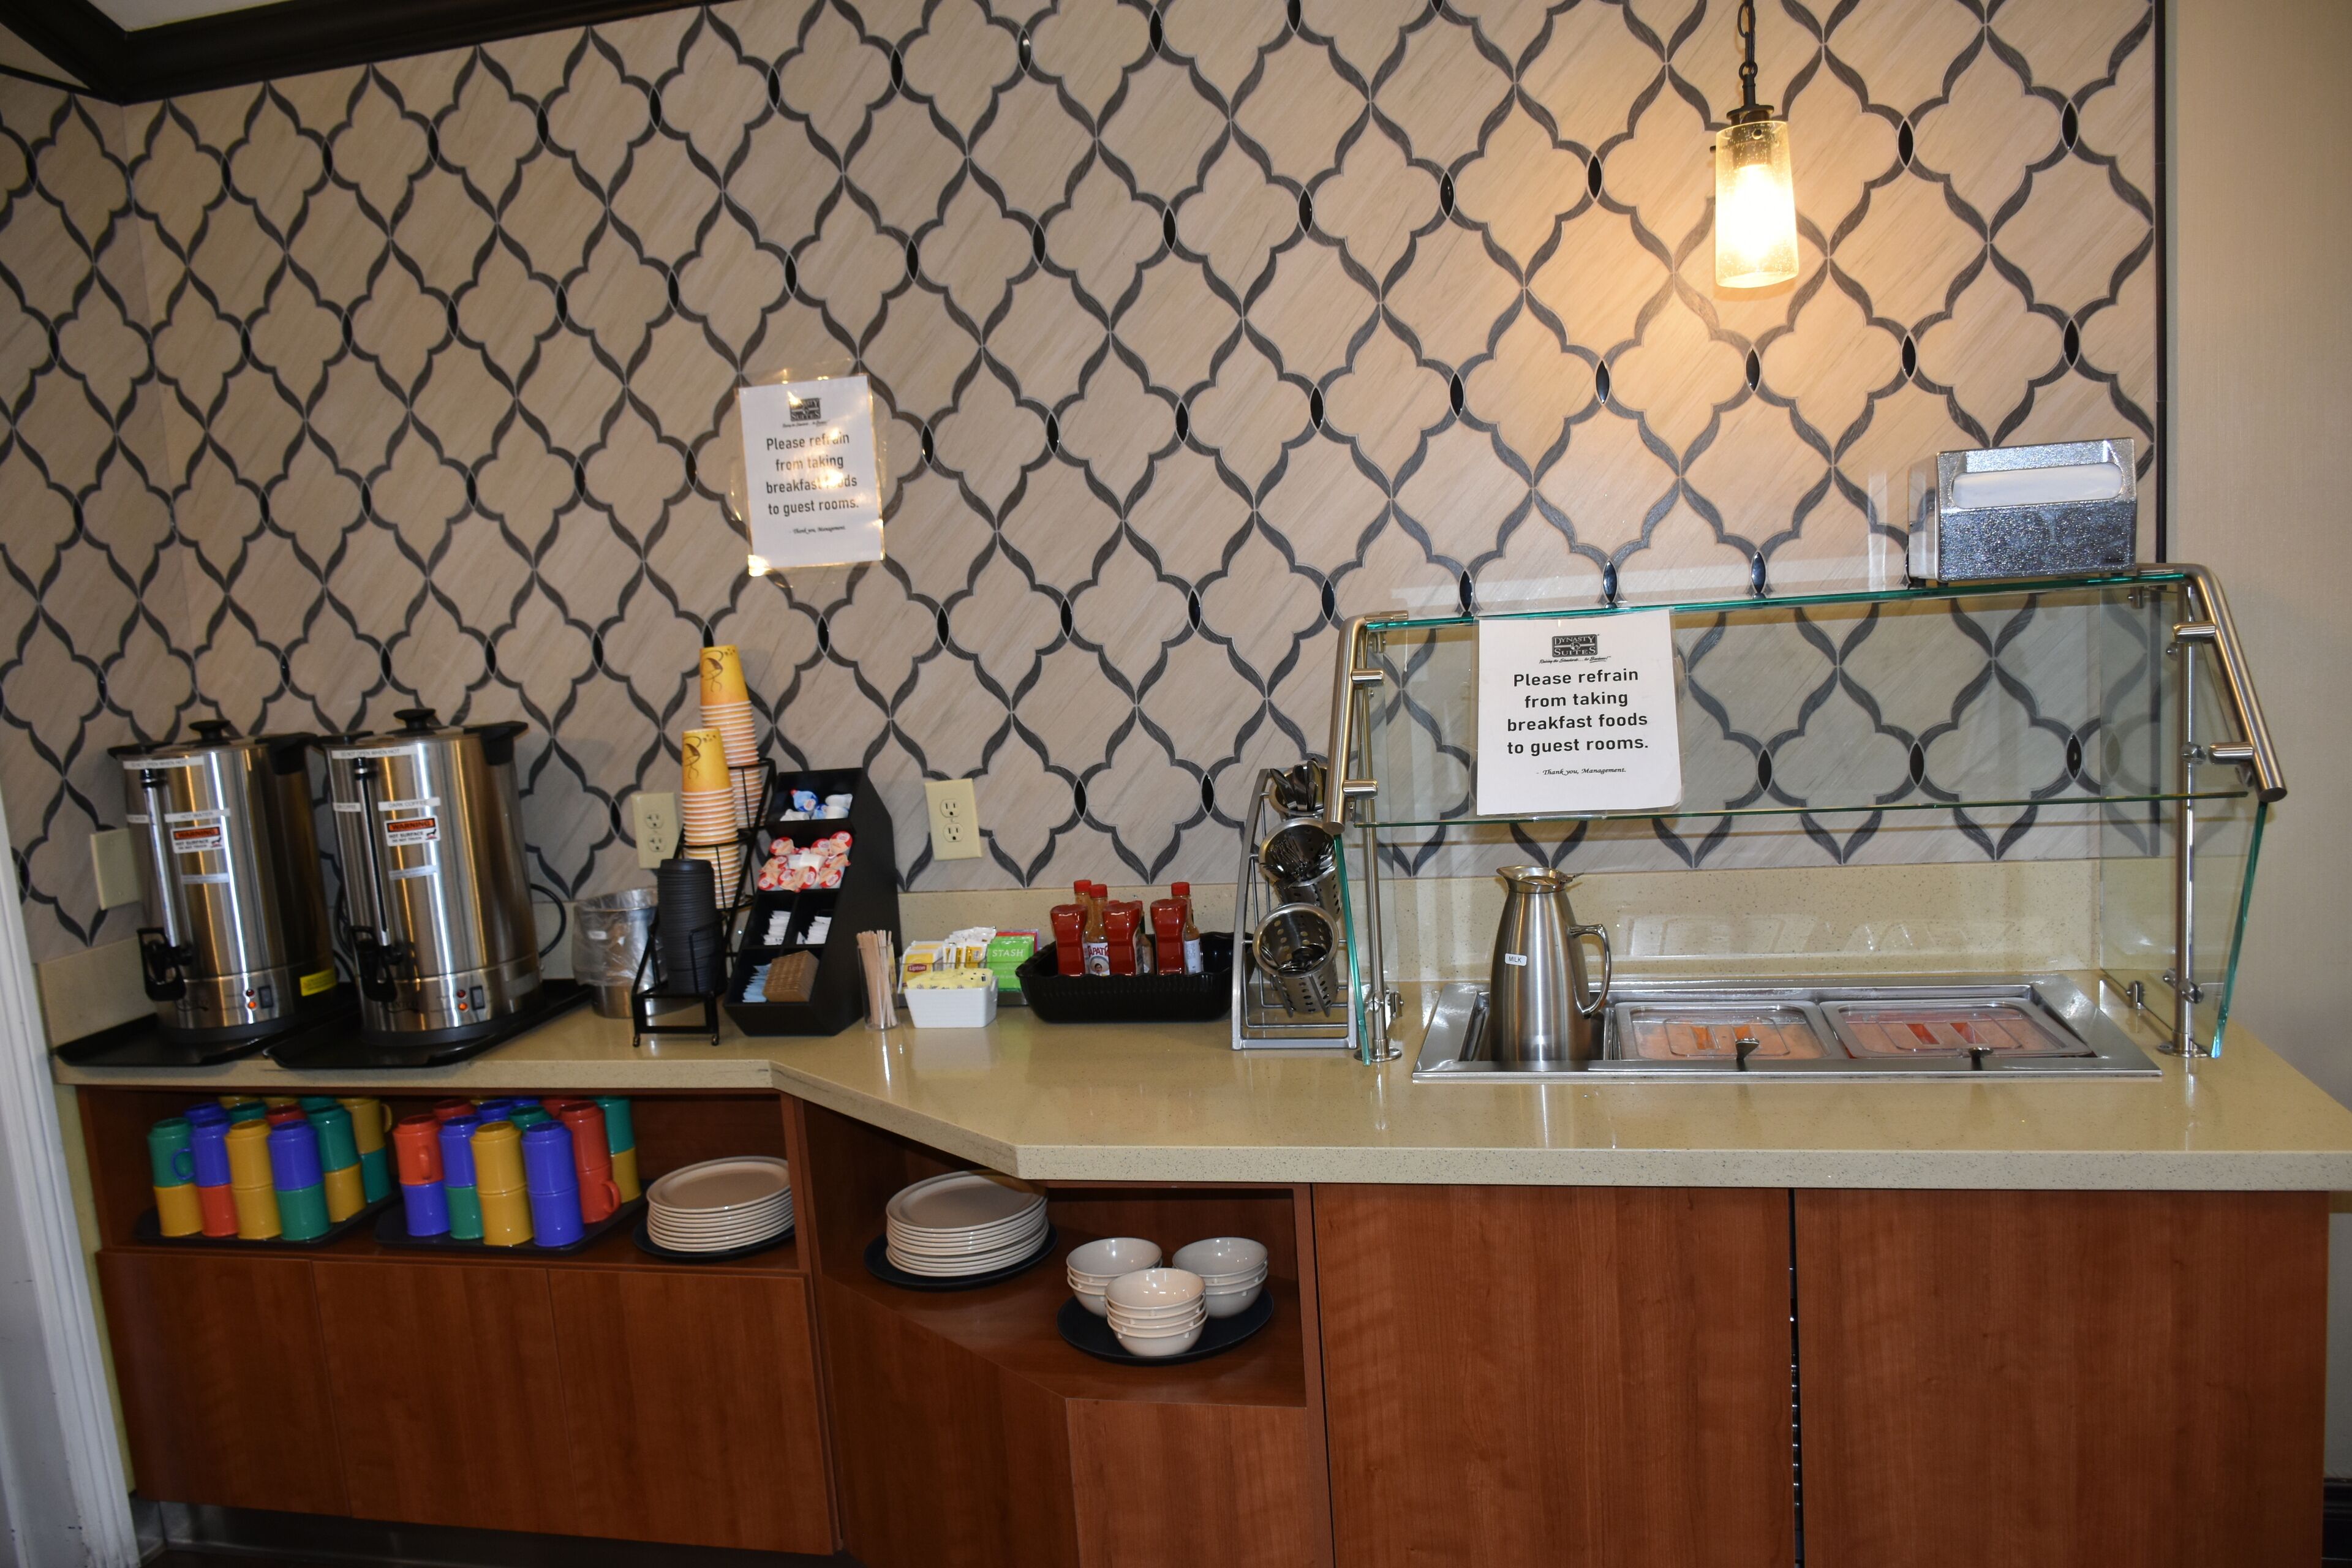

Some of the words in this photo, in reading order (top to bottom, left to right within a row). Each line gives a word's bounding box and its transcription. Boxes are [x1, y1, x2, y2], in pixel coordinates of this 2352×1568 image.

[766, 437, 805, 451] Please
[775, 459, 804, 471] from
[807, 454, 844, 469] taking
[766, 478, 821, 494] breakfast
[768, 503, 779, 515] to
[783, 500, 815, 517] guest
[819, 498, 859, 511] rooms.
[1554, 636, 1595, 645] DYNASTY
[1554, 647, 1596, 656] SUITES
[1513, 674, 1572, 687] Please
[1578, 668, 1638, 683] refrain
[1525, 696, 1566, 708] from
[1573, 692, 1628, 707] taking
[1507, 715, 1593, 731] breakfast
[1599, 713, 1648, 727] foods
[1507, 742, 1524, 754] to
[1531, 739, 1580, 756] guest
[1586, 738, 1649, 750] rooms.
[392, 821, 431, 830] WARNING
